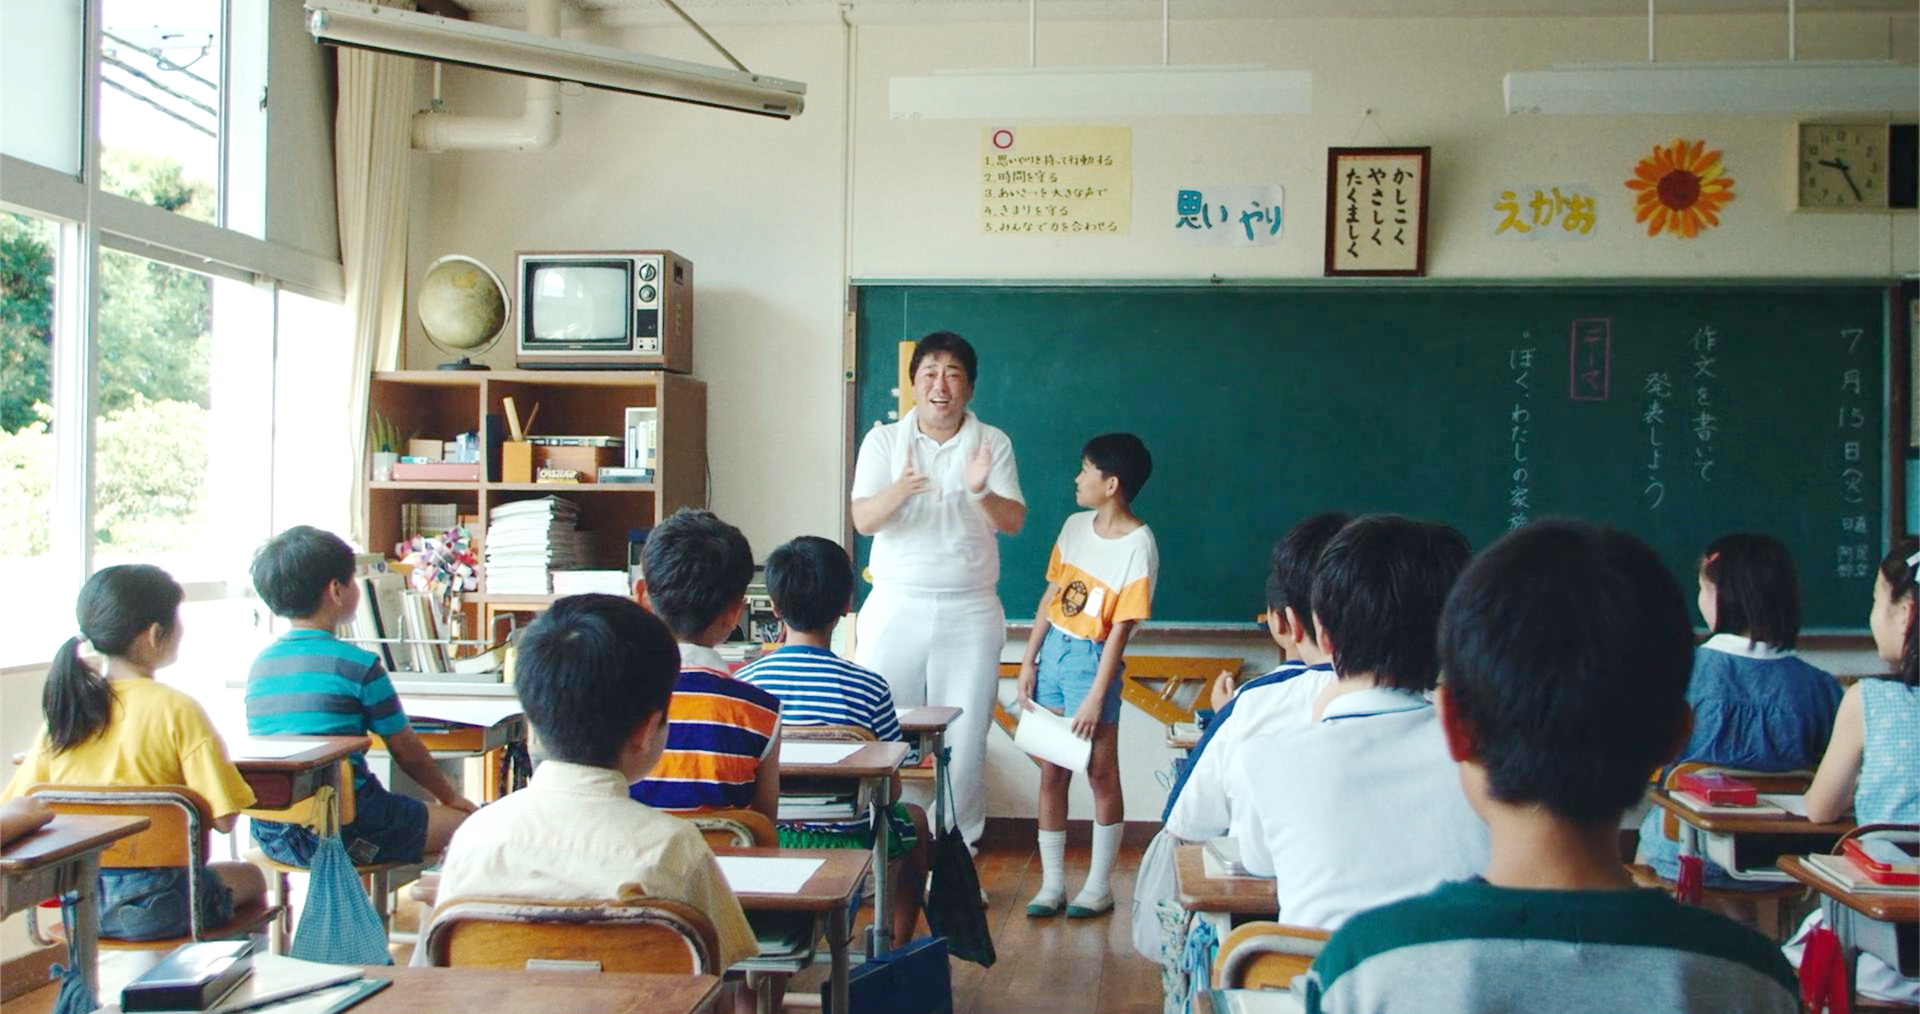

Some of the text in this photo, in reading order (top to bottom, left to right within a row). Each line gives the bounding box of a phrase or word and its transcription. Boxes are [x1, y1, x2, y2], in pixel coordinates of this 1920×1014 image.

[1346, 167, 1363, 258] たくましく
[1367, 167, 1387, 247] やさしく
[1393, 167, 1413, 246] かしこく
[1642, 372, 1672, 511] 発表しよう
[1690, 325, 1718, 482] 作文を書いて
